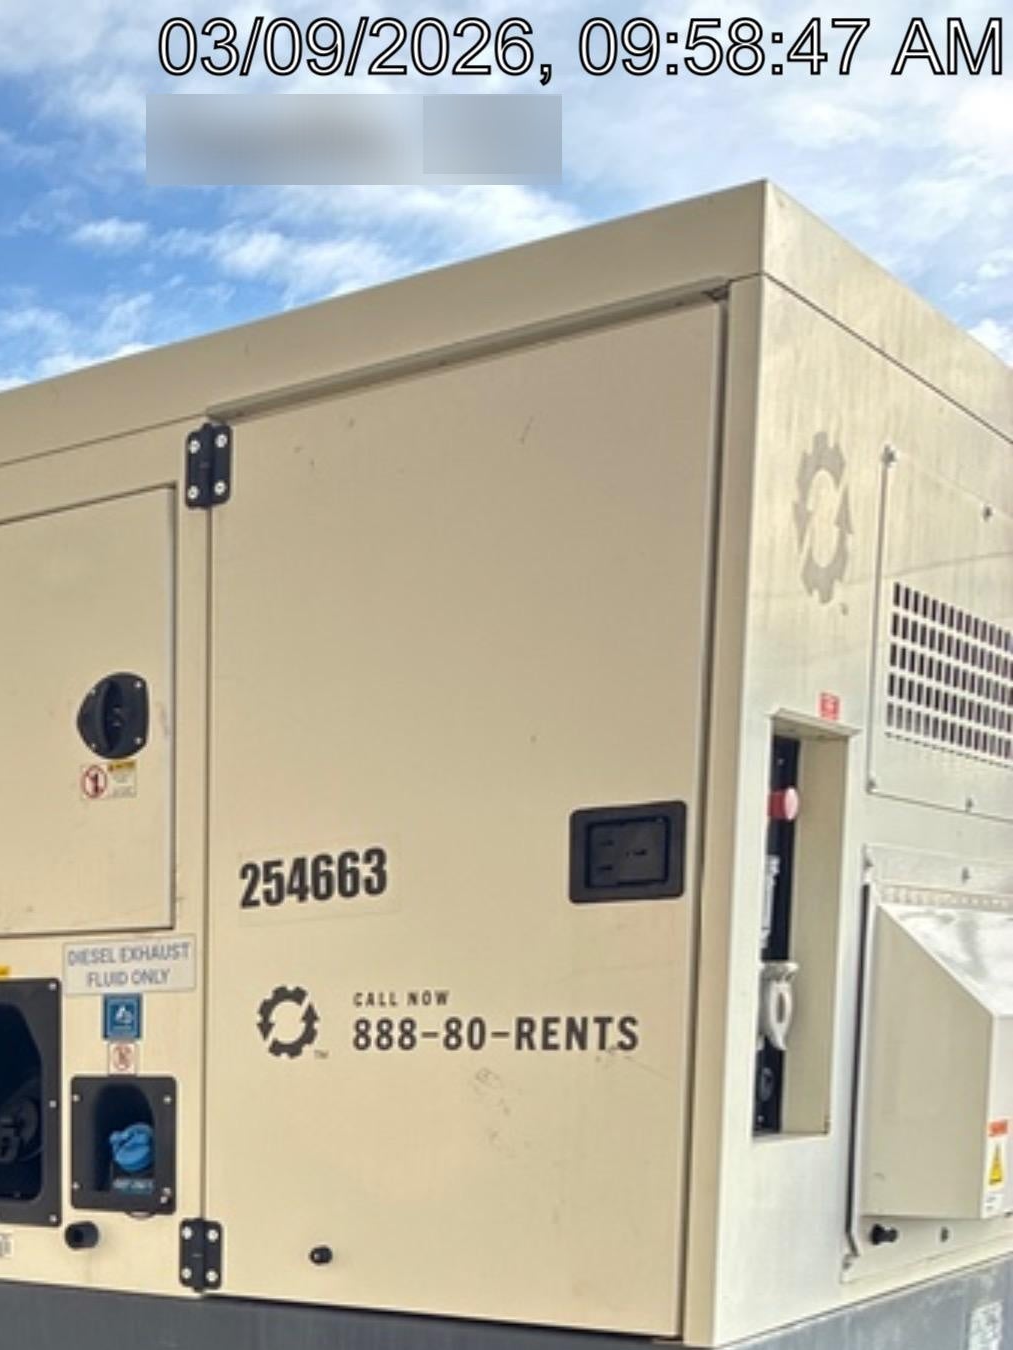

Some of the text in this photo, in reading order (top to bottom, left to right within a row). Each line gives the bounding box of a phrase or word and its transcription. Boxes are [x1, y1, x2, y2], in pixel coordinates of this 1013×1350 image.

[239, 847, 387, 909] 254663
[67, 941, 191, 966] DIESEL EXHAUST
[86, 968, 171, 988] FLUID ONLY
[352, 989, 450, 1008] CALL NOW
[352, 1015, 640, 1052] 888-80-RENTS
